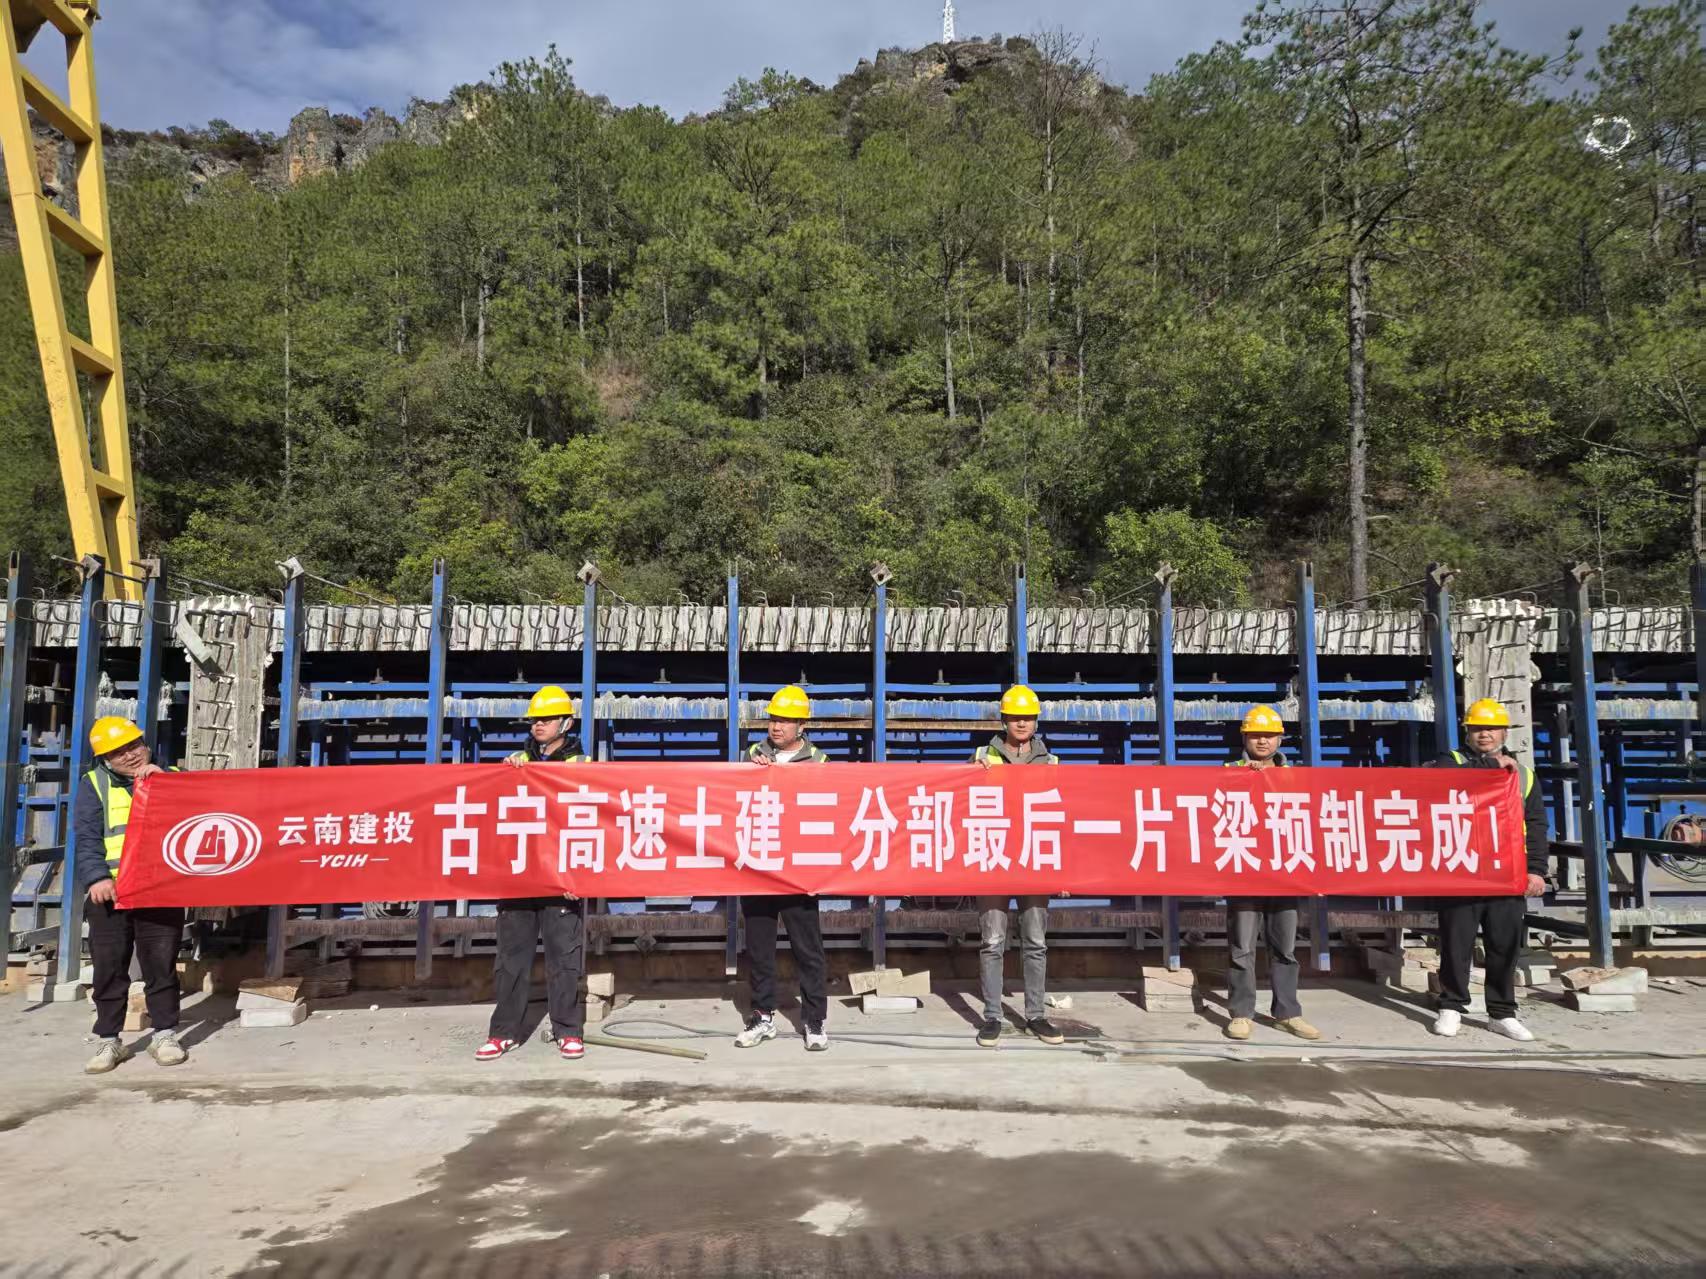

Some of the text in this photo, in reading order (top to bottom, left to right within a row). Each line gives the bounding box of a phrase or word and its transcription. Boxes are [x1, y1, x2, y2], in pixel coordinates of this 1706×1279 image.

[278, 811, 415, 846] 云南建投
[433, 783, 1501, 876] 古宁高速土建三分部最后一片T梁预制完成！
[319, 853, 369, 869] YCIH
